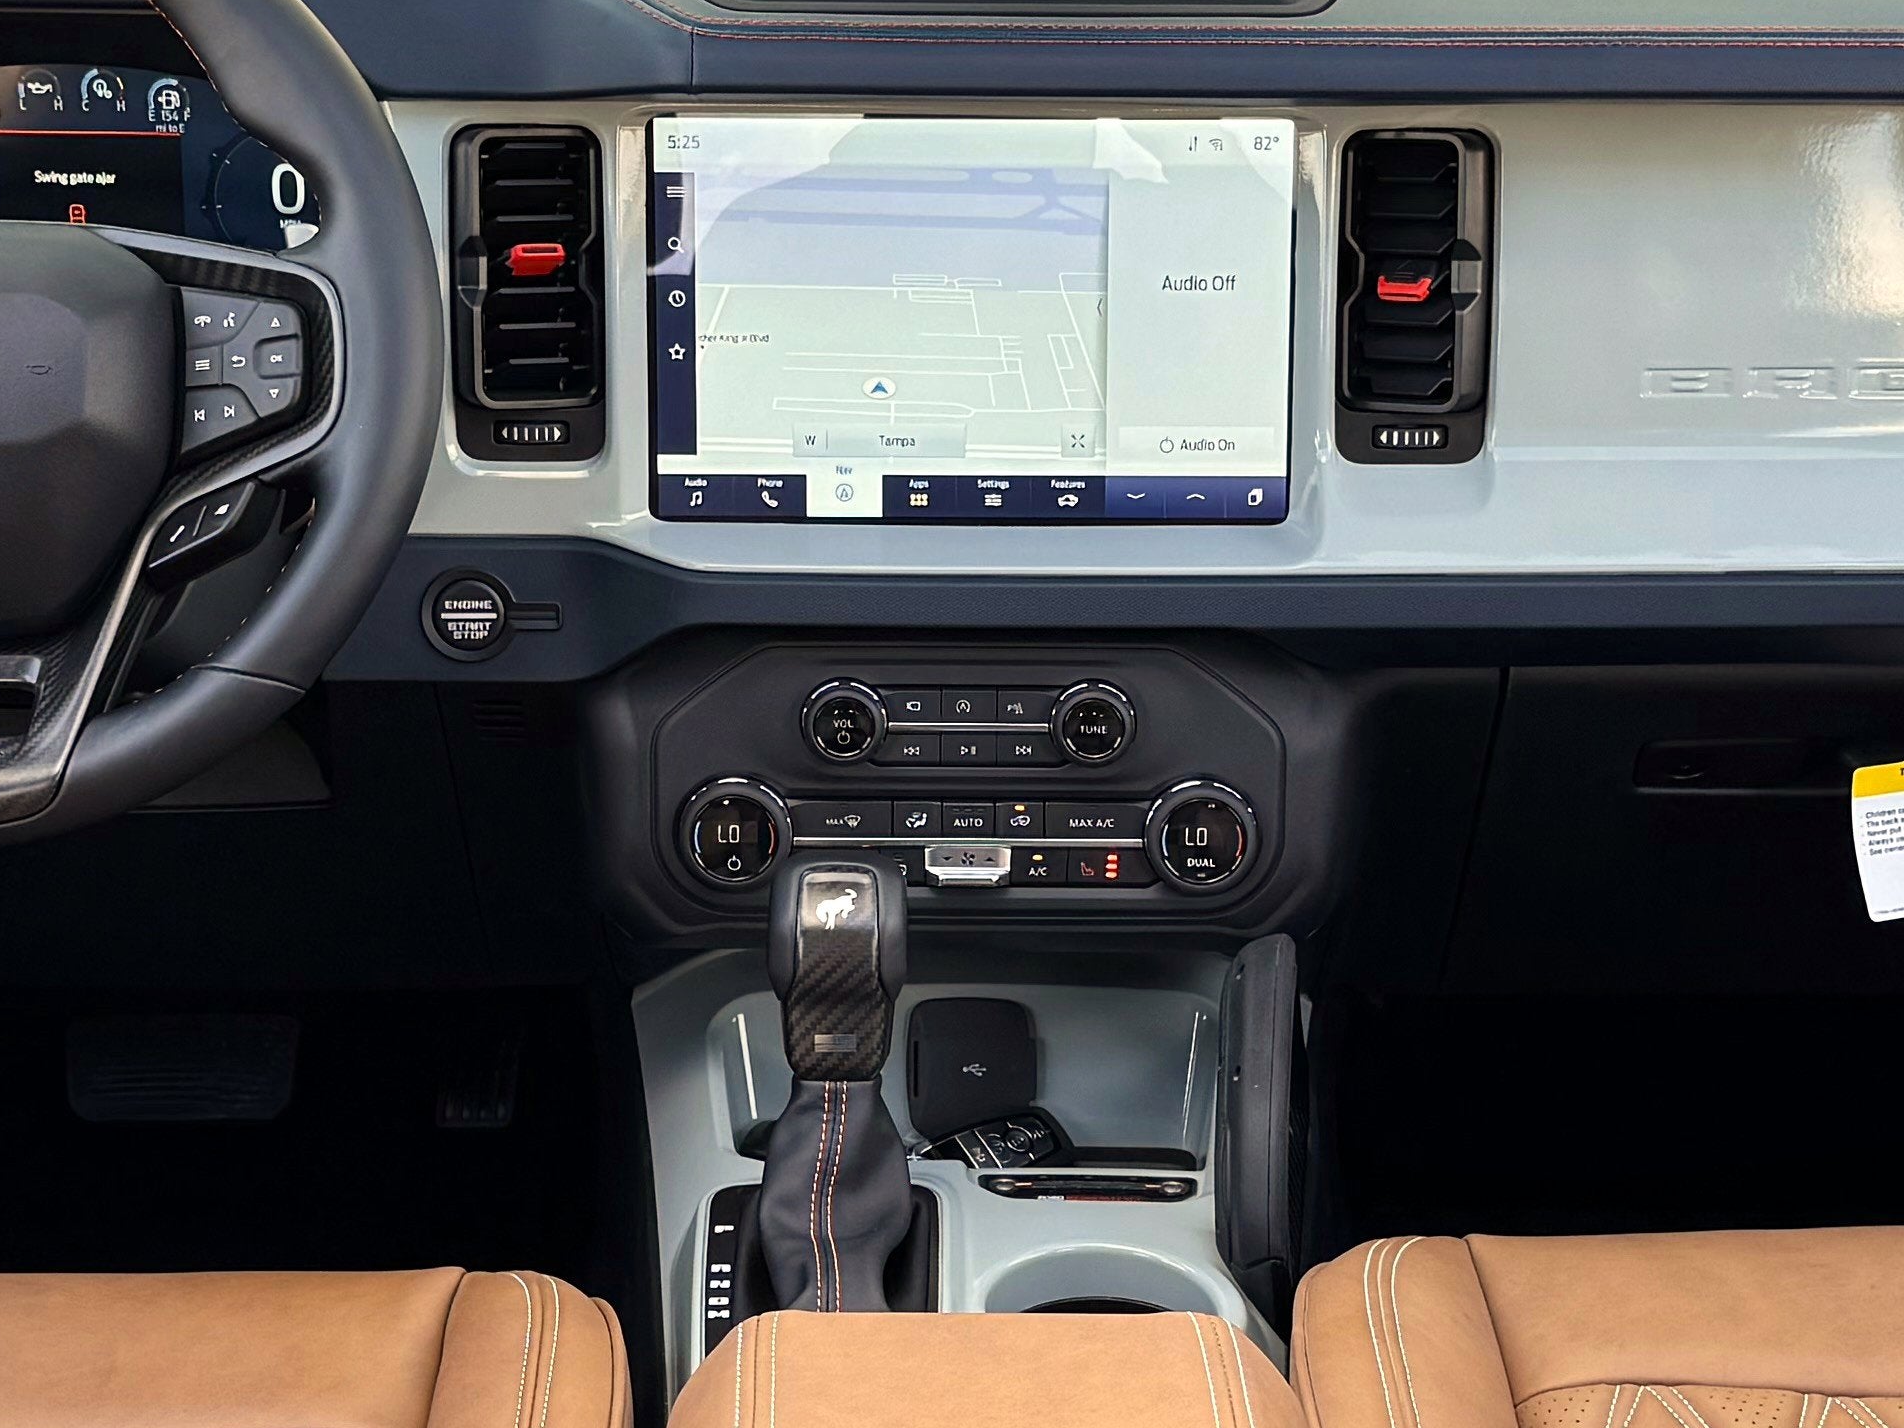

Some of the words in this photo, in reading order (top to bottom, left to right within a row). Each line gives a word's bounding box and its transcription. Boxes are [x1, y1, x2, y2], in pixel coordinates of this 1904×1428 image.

[667, 134, 701, 150] 5:25
[34, 170, 69, 186] Swing
[70, 171, 94, 186] gate
[95, 172, 117, 186] ajar
[272, 163, 305, 215] 0
[1161, 275, 1208, 292] Audio
[1212, 275, 1237, 292] Off
[804, 435, 817, 446] W
[878, 435, 916, 448] Tampa
[1180, 438, 1215, 452] Audio
[1218, 438, 1236, 452] On
[444, 600, 493, 610] ENGINE
[453, 631, 489, 640] STOP
[832, 719, 854, 729] VOL
[1080, 725, 1108, 735] TUNE
[953, 818, 984, 827] AUTO
[1069, 818, 1094, 828] MAX
[1096, 818, 1115, 828] A/C
[717, 824, 740, 843] LO
[1185, 827, 1208, 846] LO
[1187, 858, 1216, 868] DUAL
[1028, 866, 1047, 876] A/C
